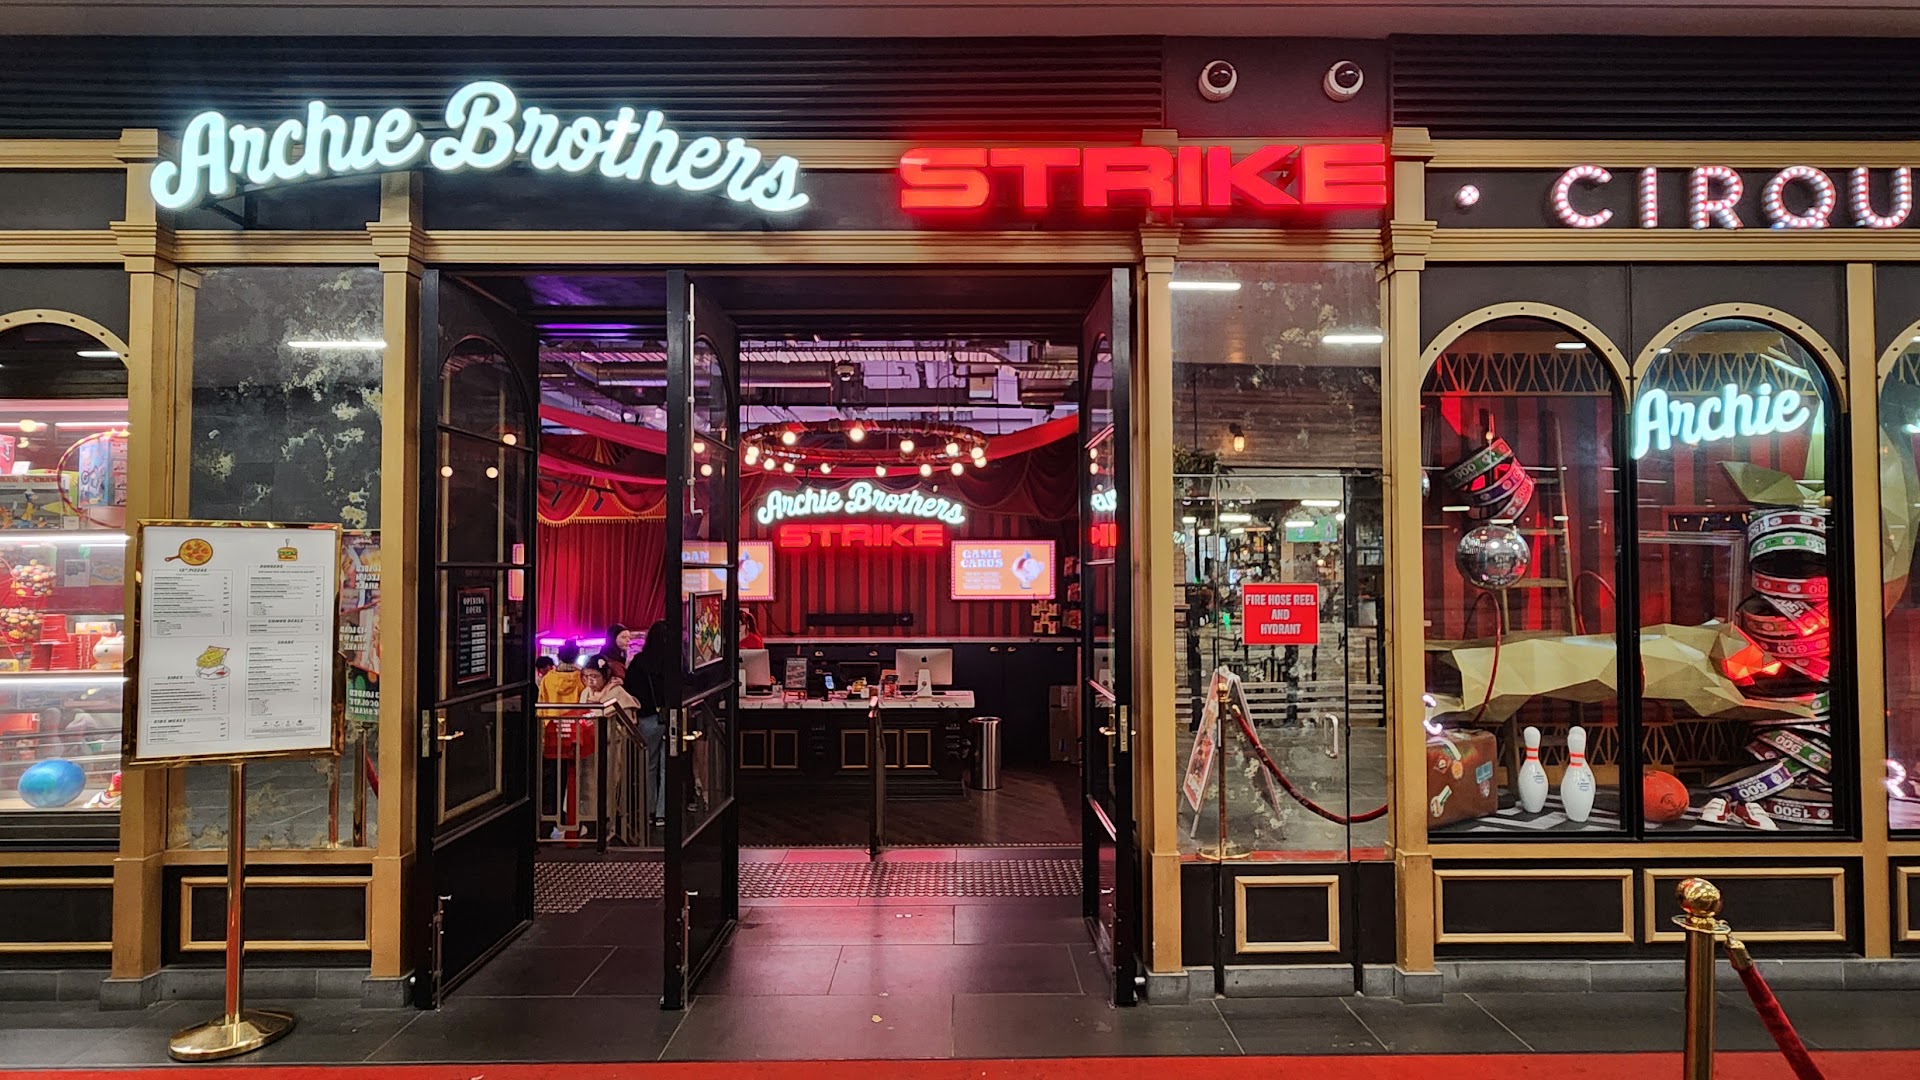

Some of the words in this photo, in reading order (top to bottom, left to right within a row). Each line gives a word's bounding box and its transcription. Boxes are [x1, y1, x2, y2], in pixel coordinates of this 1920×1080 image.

[150, 100, 425, 209] Archie
[430, 80, 810, 212] Brothers
[900, 143, 1387, 209] STRIKE
[1551, 165, 1912, 229] CIRQU
[1631, 383, 1810, 460] Archie
[757, 489, 844, 524] Archie
[845, 481, 966, 525] Brothers
[780, 524, 944, 548] STRIKE
[960, 558, 1003, 568] CARDS
[1245, 594, 1267, 606] FIRE
[1267, 594, 1292, 606] HOSE
[1293, 594, 1316, 606] REEL
[1271, 608, 1290, 620] AND
[1260, 623, 1301, 635] HYDRANT
[1775, 735, 1803, 754] 900
[1738, 782, 1768, 799] 600
[1773, 804, 1812, 818] 1500
